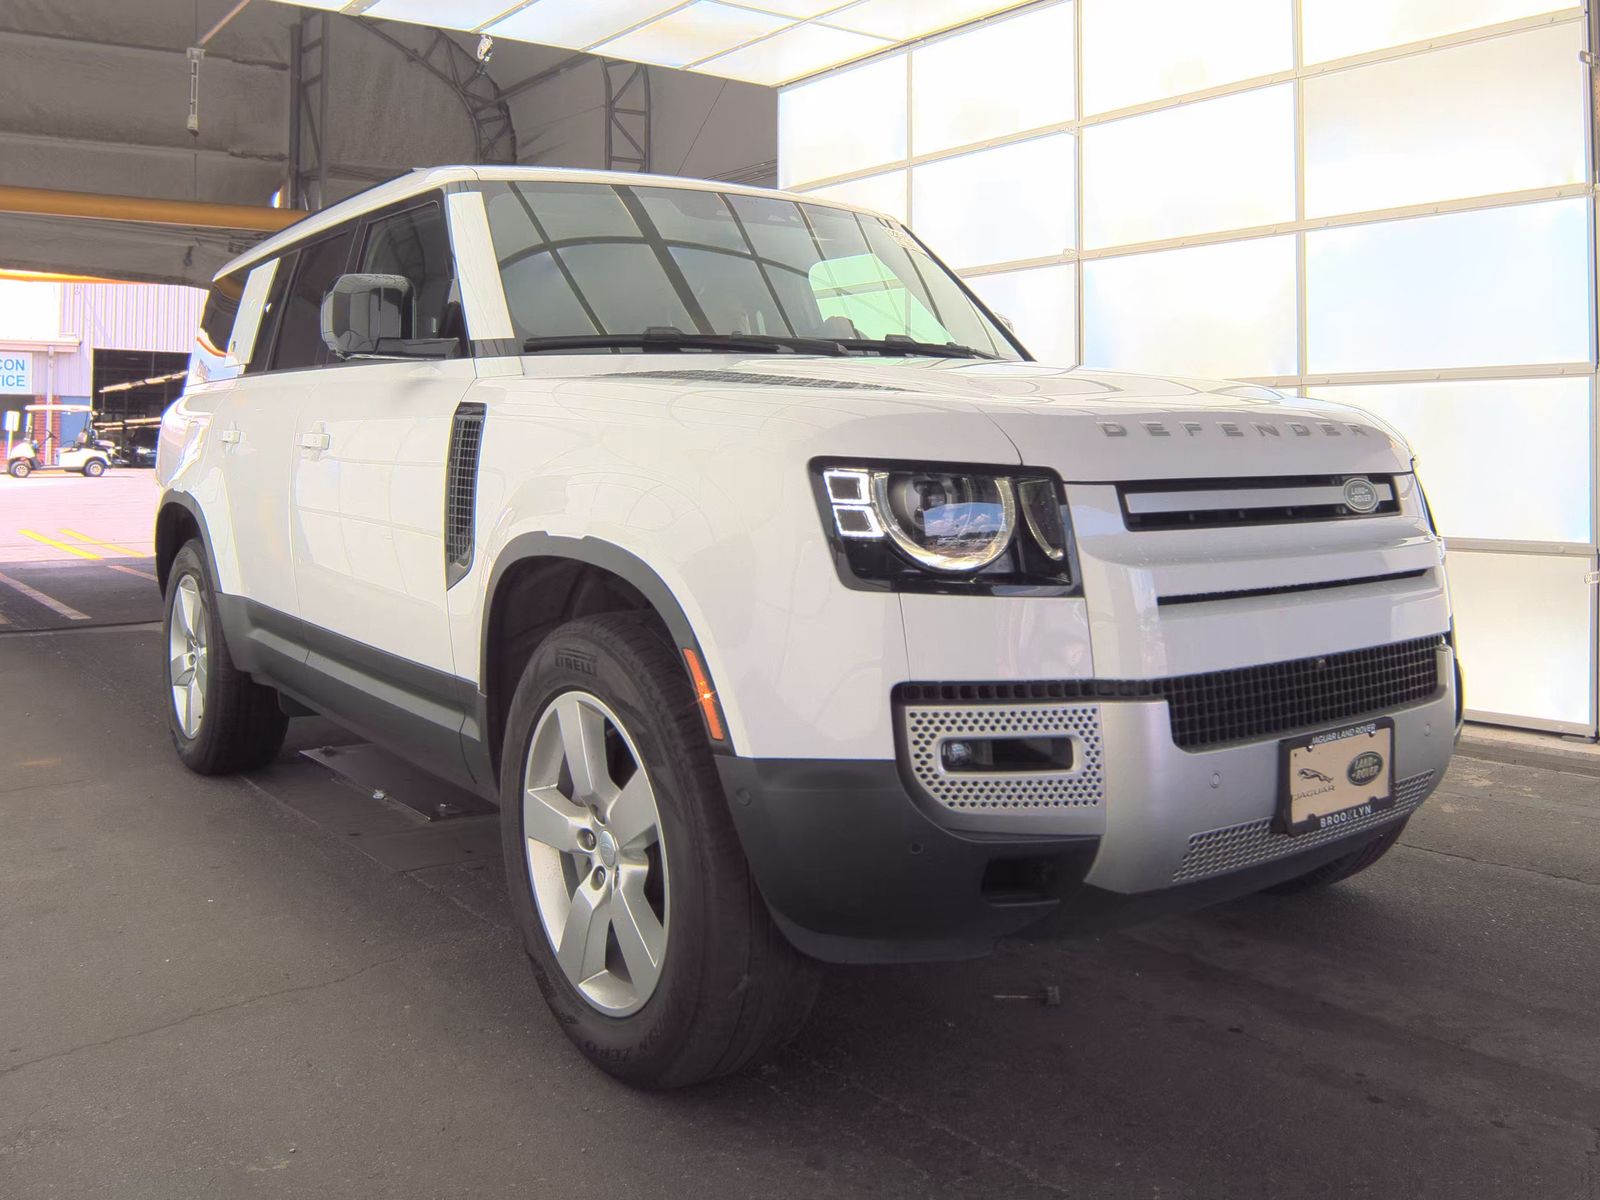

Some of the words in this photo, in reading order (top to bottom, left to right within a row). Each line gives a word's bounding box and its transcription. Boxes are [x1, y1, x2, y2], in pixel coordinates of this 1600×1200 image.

[1099, 420, 1369, 438] DEFENDER
[1312, 732, 1337, 744] JAGUAR
[1337, 728, 1355, 739] LAND
[1355, 723, 1377, 735] ROVER
[1354, 757, 1375, 770] LAND
[1355, 765, 1379, 780] ROVER
[1294, 784, 1336, 801] JAGUAR
[1320, 805, 1372, 828] BROOKLYN
